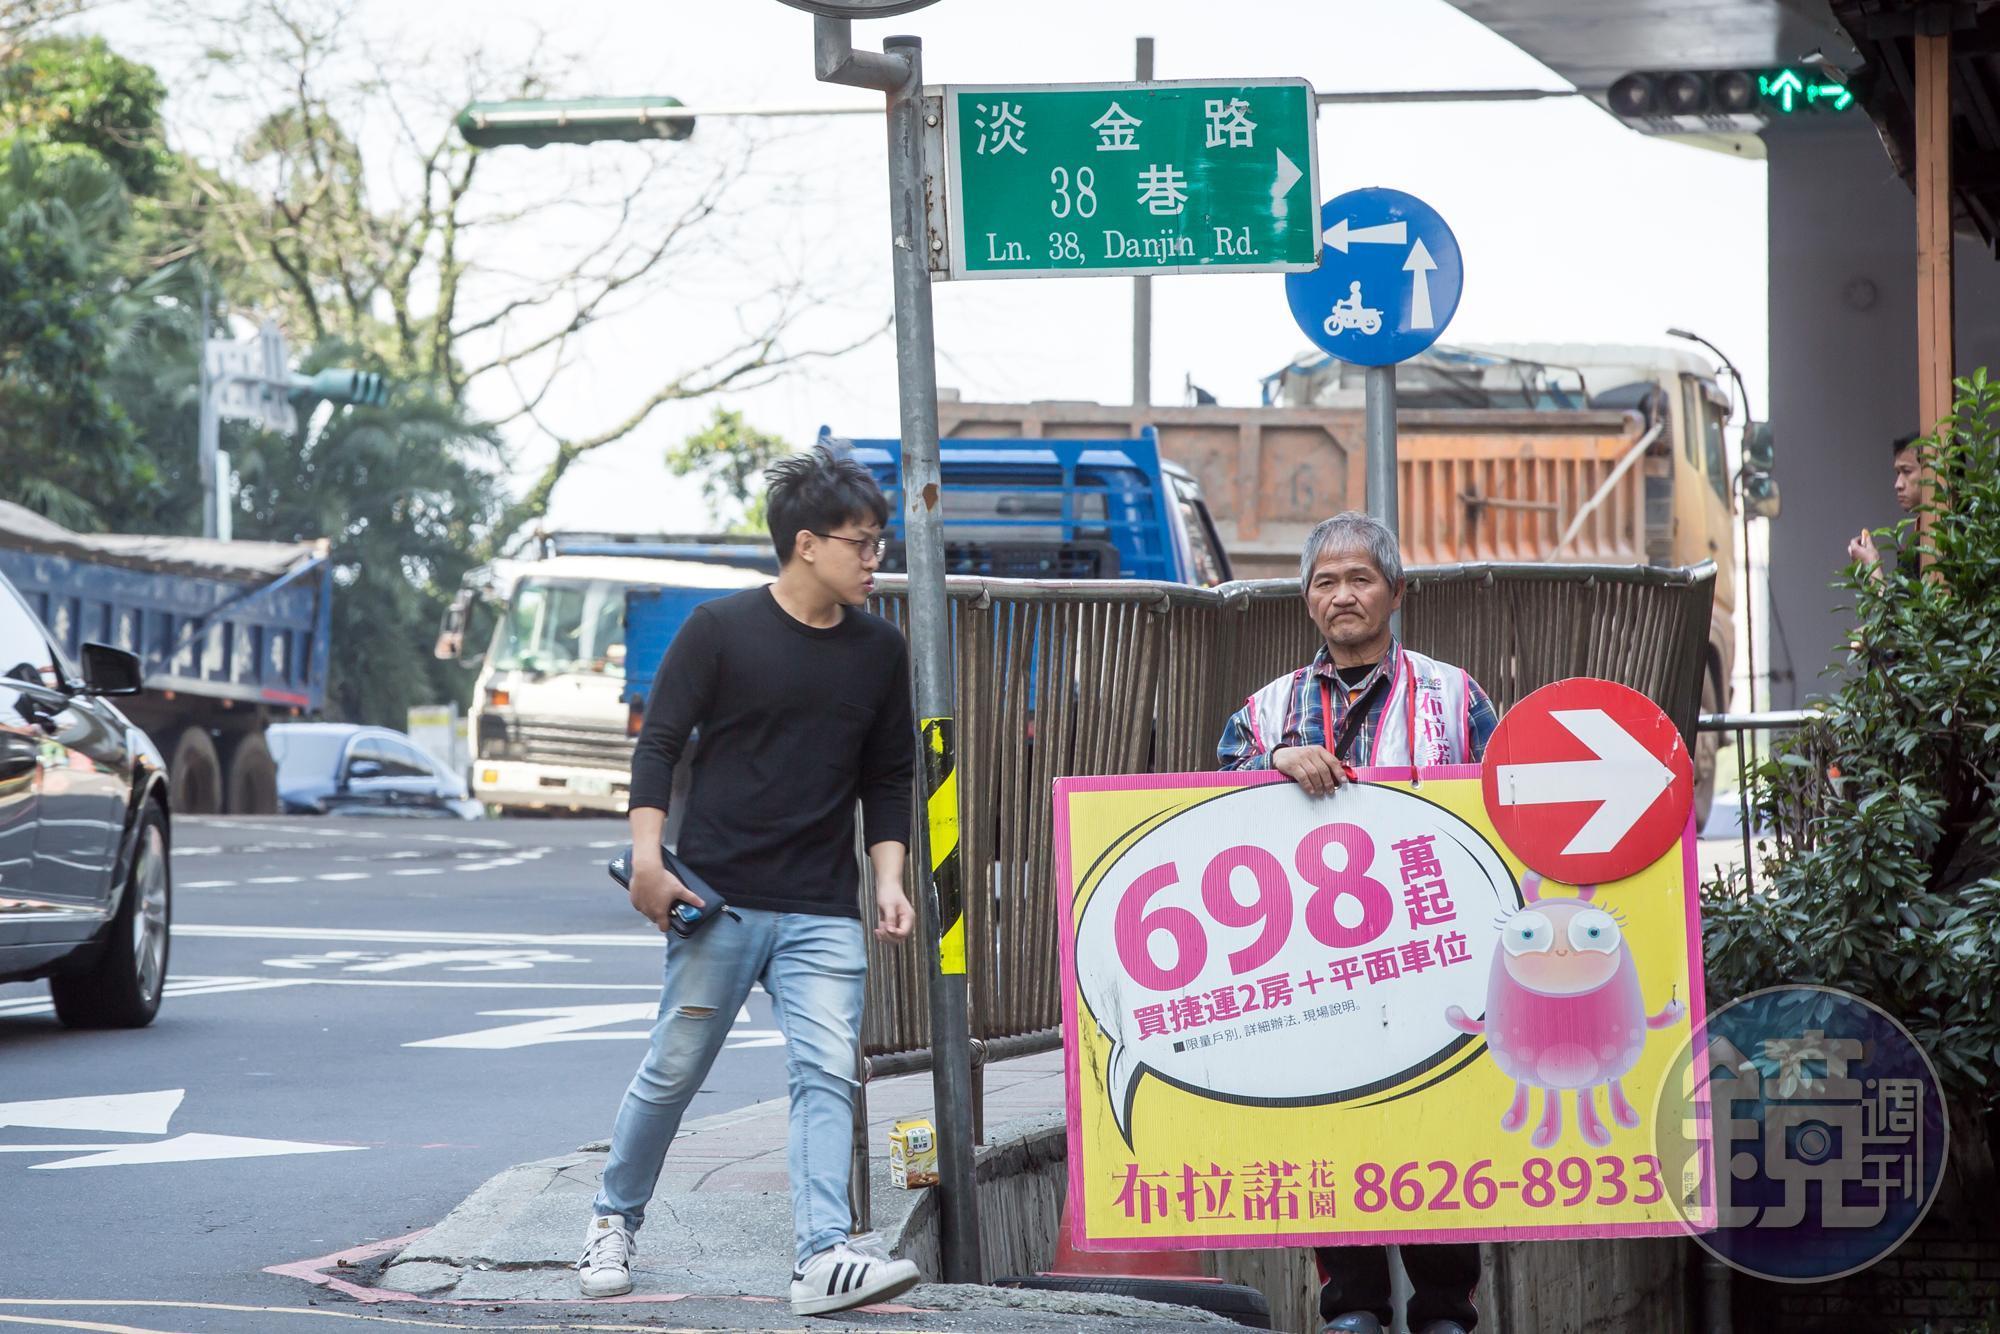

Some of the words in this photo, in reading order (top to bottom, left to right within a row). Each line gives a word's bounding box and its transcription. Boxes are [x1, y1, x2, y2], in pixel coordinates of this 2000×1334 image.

[975, 97, 1258, 156] 淡金路
[987, 233, 1031, 262] Ln.
[1048, 231, 1086, 264] 38,
[1103, 229, 1196, 264] Danjin
[1215, 226, 1260, 257] Rd.
[1114, 822, 1394, 992] 698
[1391, 834, 1457, 931] 萬起
[1112, 1160, 1302, 1224] 布拉諾
[1306, 1159, 1337, 1219] 花園
[1353, 1153, 1664, 1213] 8626-8933
